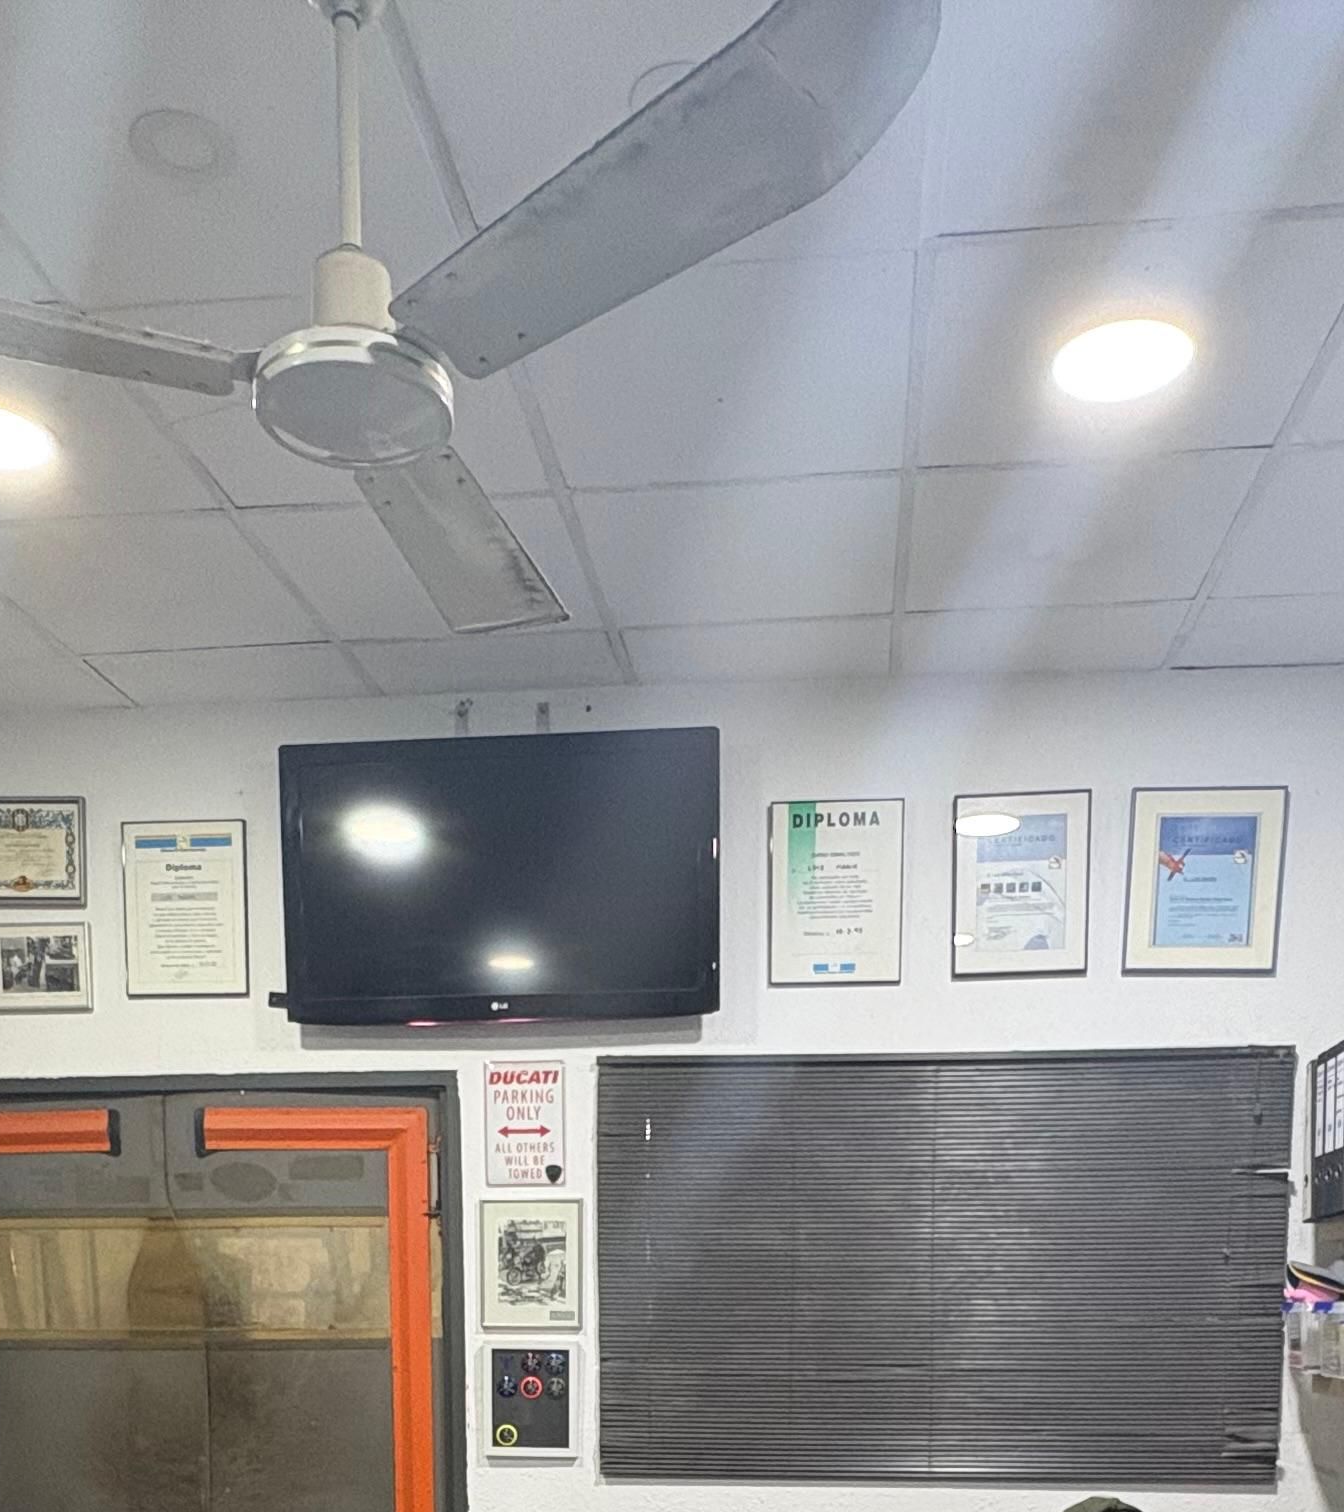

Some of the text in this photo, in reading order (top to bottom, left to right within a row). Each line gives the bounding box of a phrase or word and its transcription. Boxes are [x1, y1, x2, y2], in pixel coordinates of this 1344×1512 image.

[792, 811, 881, 828] DIPLOMA
[165, 863, 202, 872] Diploma
[488, 1070, 559, 1085] DUCATI
[493, 1089, 555, 1104] PARKING
[506, 1106, 542, 1120] ONLY
[495, 1142, 555, 1153] ALL OTHERS
[504, 1155, 545, 1166] WILL BE
[508, 1167, 543, 1179] TOWED
